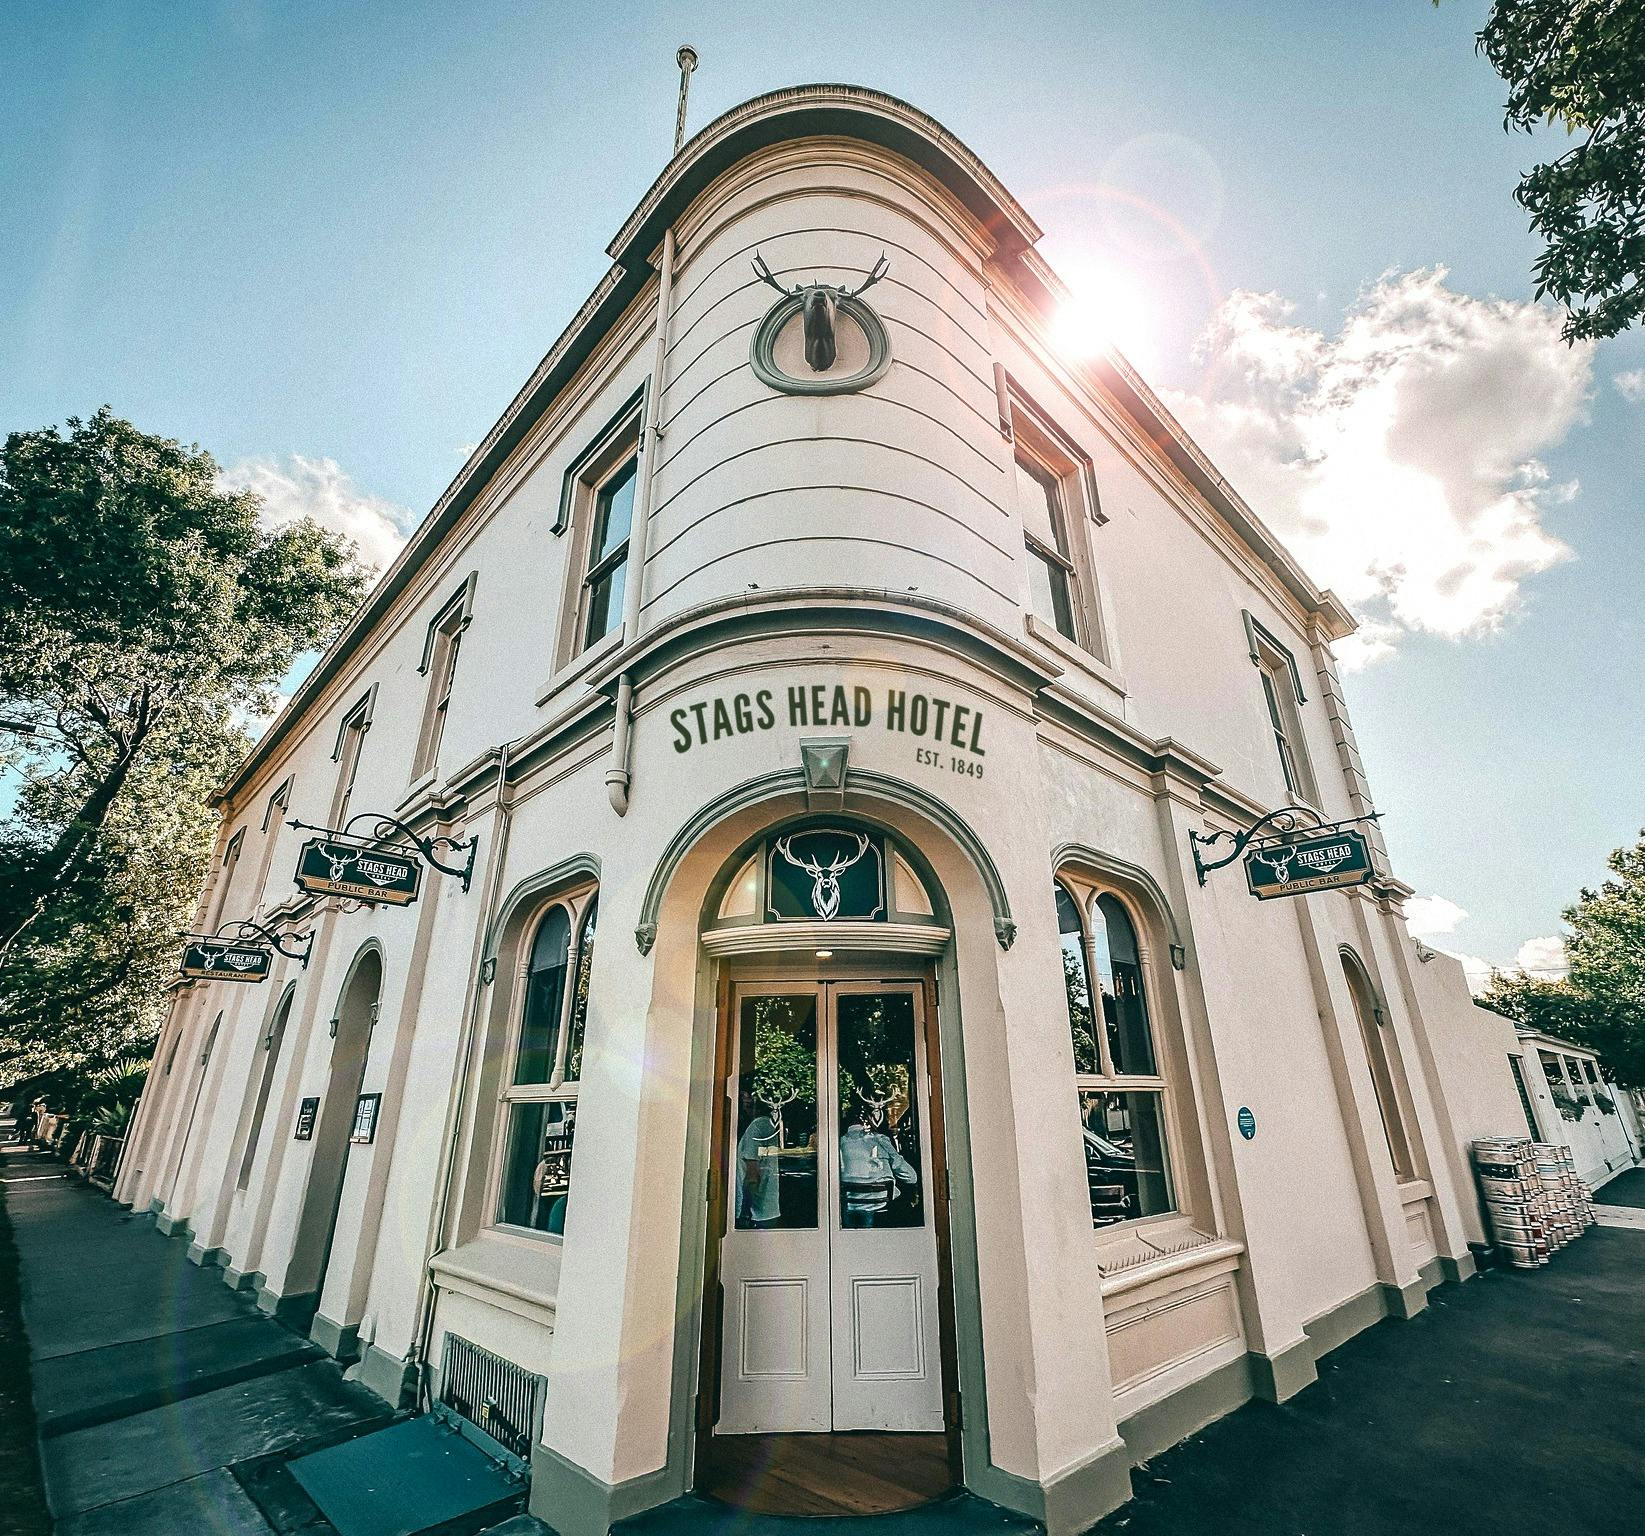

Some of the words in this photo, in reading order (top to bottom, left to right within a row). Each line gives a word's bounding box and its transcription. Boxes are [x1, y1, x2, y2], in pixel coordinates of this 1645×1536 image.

[670, 689, 776, 754] STAGS
[788, 685, 872, 727] HEAD
[887, 689, 986, 757] HOTEL
[916, 748, 944, 769] EST.
[951, 757, 984, 779] 1849
[1296, 850, 1326, 864] STAGS
[1327, 845, 1352, 859] HEAD
[357, 860, 385, 874] STAGS
[386, 865, 408, 878] HEAD
[327, 882, 364, 894] PUBLIC
[367, 889, 388, 898] BAR
[1279, 880, 1316, 892] PUBLIC
[1319, 875, 1341, 885] BAR
[224, 954, 245, 963] STAGS
[245, 956, 262, 964] HEAD
[201, 970, 248, 979] RESTAURANT
